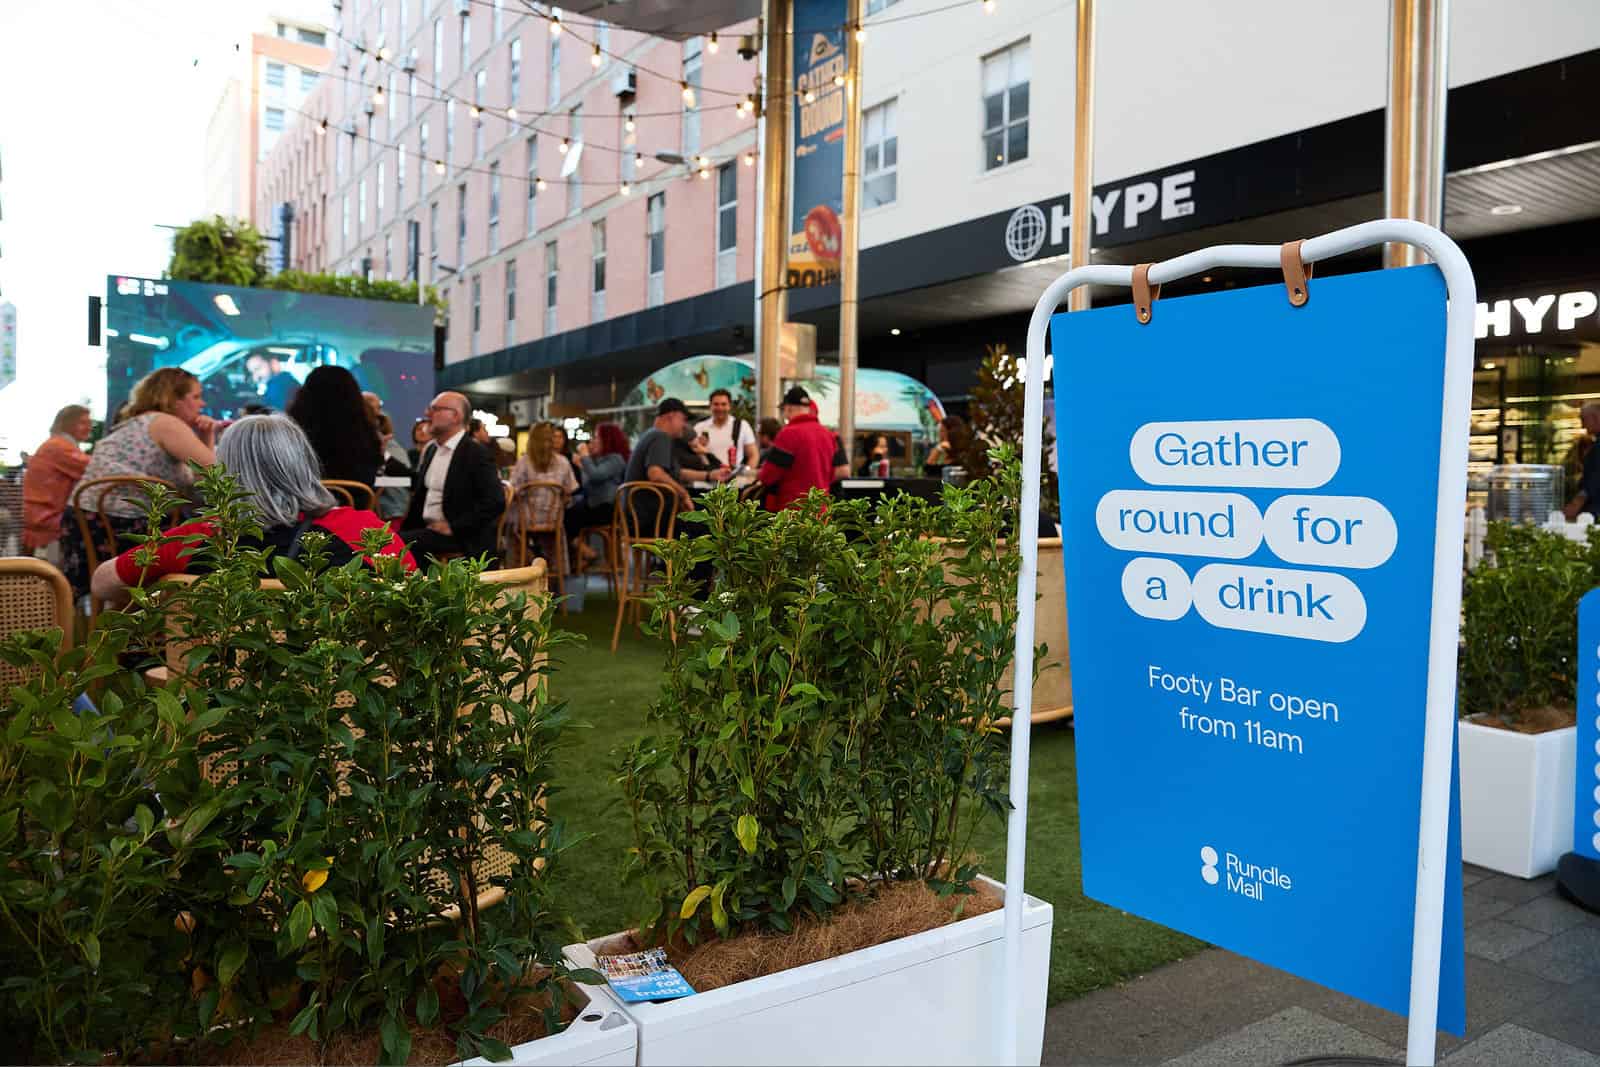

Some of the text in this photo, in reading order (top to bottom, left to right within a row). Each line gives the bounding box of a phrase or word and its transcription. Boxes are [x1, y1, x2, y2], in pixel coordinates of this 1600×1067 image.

[1051, 170, 1195, 245] HYPE
[1475, 291, 1600, 339] HYP
[1154, 432, 1308, 467] Gather
[1119, 505, 1362, 545] round for
[1145, 576, 1334, 621] a drink
[1148, 664, 1339, 723] Footy Bar open
[1179, 707, 1303, 753] from 11am
[1226, 852, 1291, 890] Rundle
[1227, 871, 1263, 901] Mall
